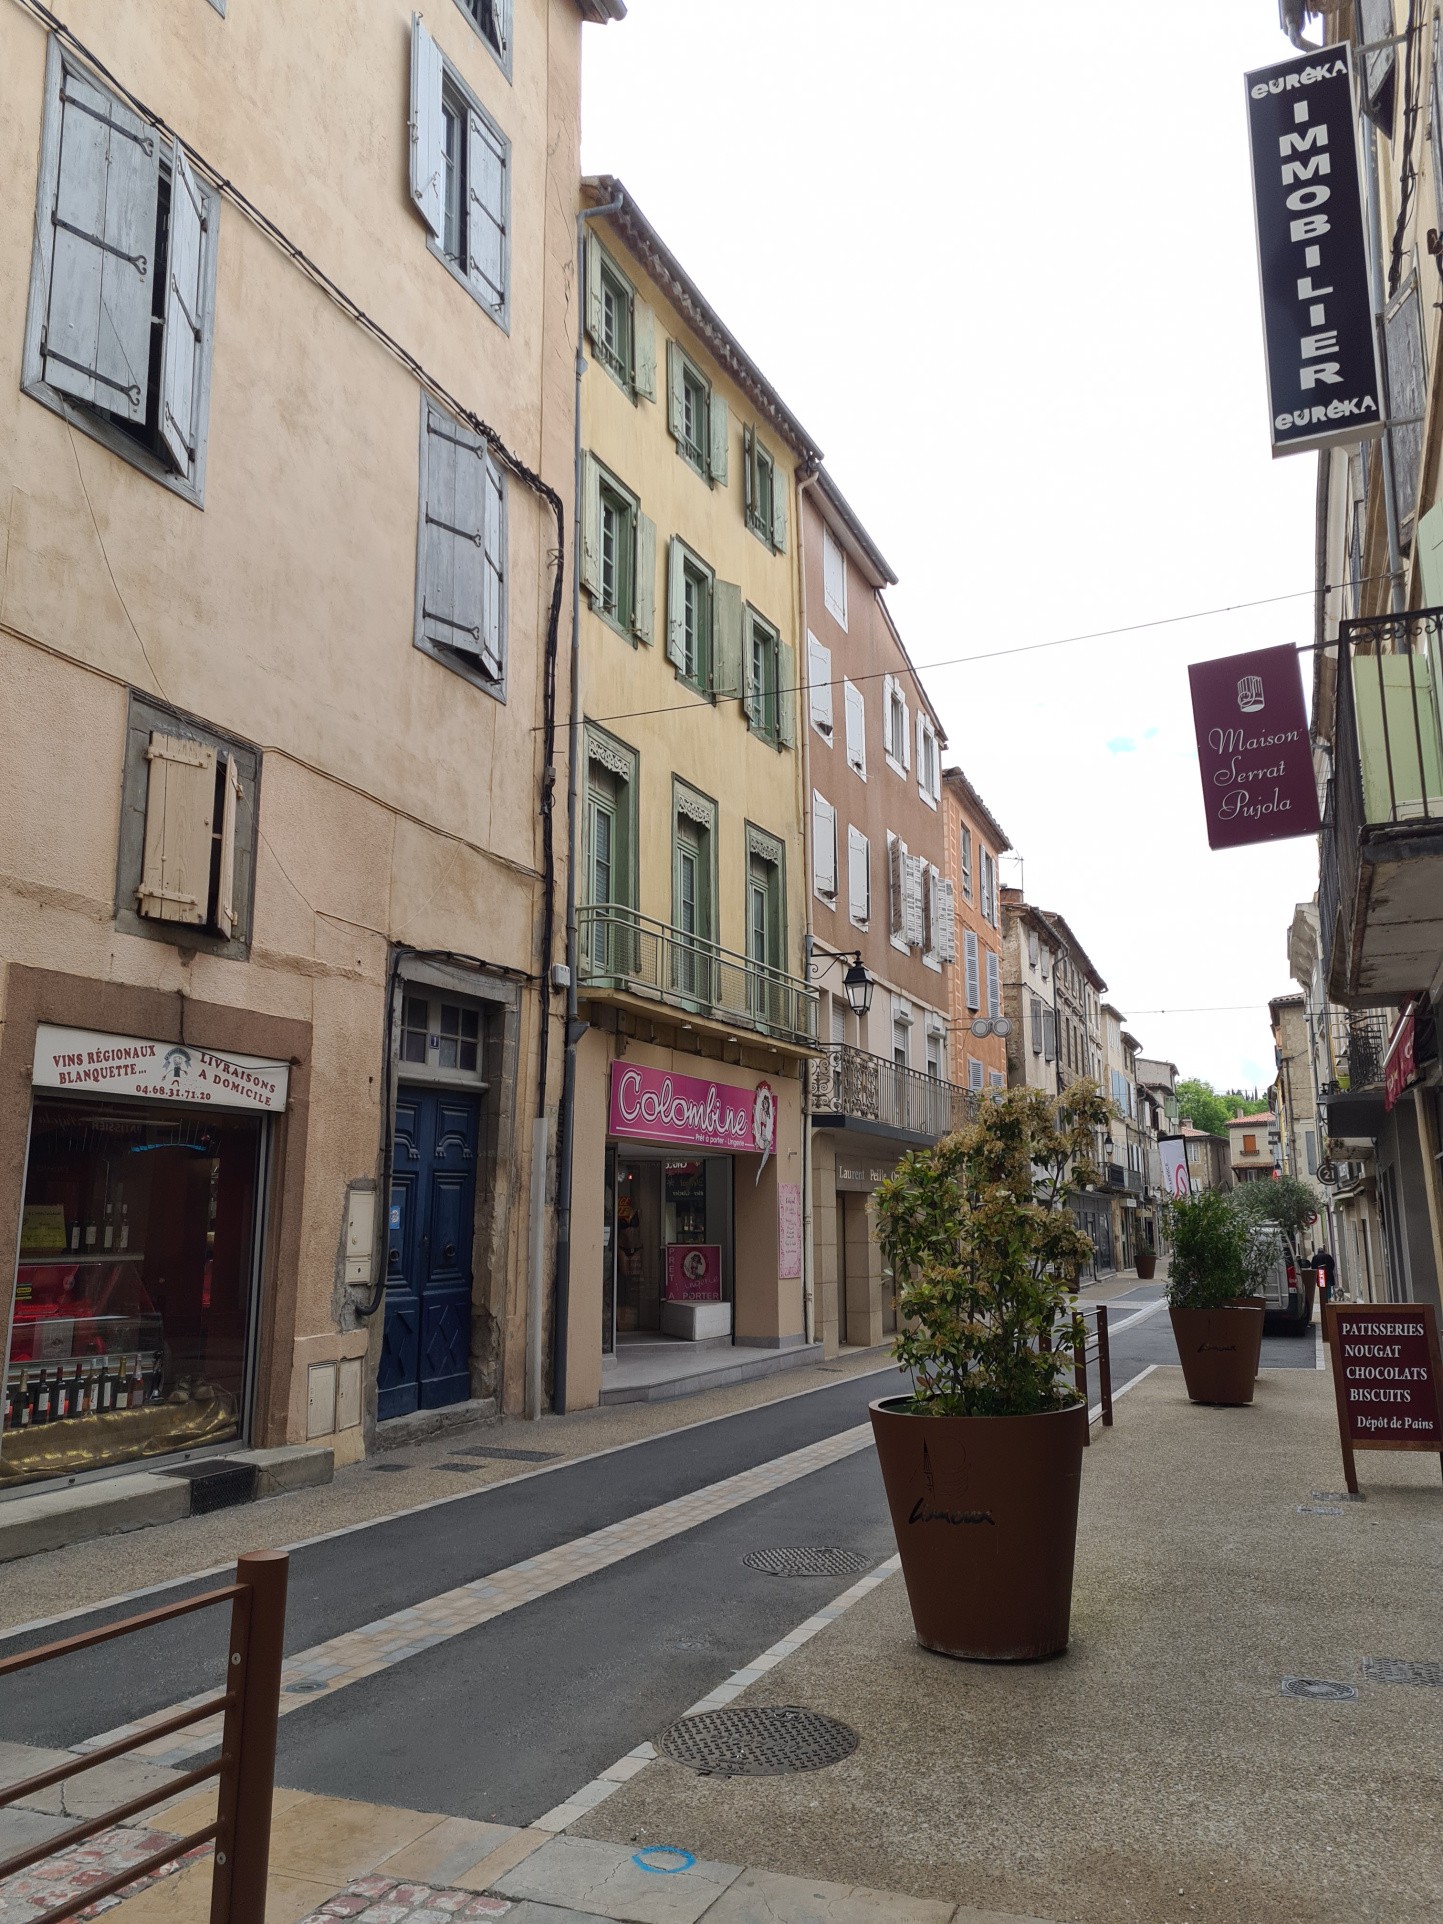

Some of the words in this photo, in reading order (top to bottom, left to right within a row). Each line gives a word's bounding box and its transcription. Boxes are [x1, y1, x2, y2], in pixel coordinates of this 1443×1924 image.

[1278, 100, 1345, 390] IMMOBILIER
[1209, 728, 1299, 755] Maison
[1213, 756, 1286, 787] Serrat
[1218, 787, 1292, 820] Pujola
[53, 1053, 83, 1068] VINS
[87, 1045, 156, 1065] RÉGIONAUX
[59, 1063, 147, 1085] BLANQUETTE...
[200, 1052, 276, 1093] LIVRAISONS
[136, 1084, 211, 1101] 04.68.31.71.20
[198, 1069, 207, 1080] A
[212, 1074, 272, 1106] DOMICILE
[619, 1068, 748, 1137] Colombine
[710, 1136, 724, 1145] porter
[728, 1138, 745, 1147] Lingerie
[839, 1166, 866, 1181] Laurent
[668, 1292, 675, 1300] A
[682, 1292, 719, 1300] PORTER
[1342, 1323, 1424, 1336] PATISSERIES
[1344, 1344, 1401, 1358] NOUGAT
[1346, 1366, 1428, 1381] CHOCOLATS
[1350, 1388, 1411, 1403] BISCUITS
[1357, 1415, 1388, 1432] Dépôt
[1390, 1416, 1402, 1429] de
[1404, 1417, 1434, 1430] Pains
